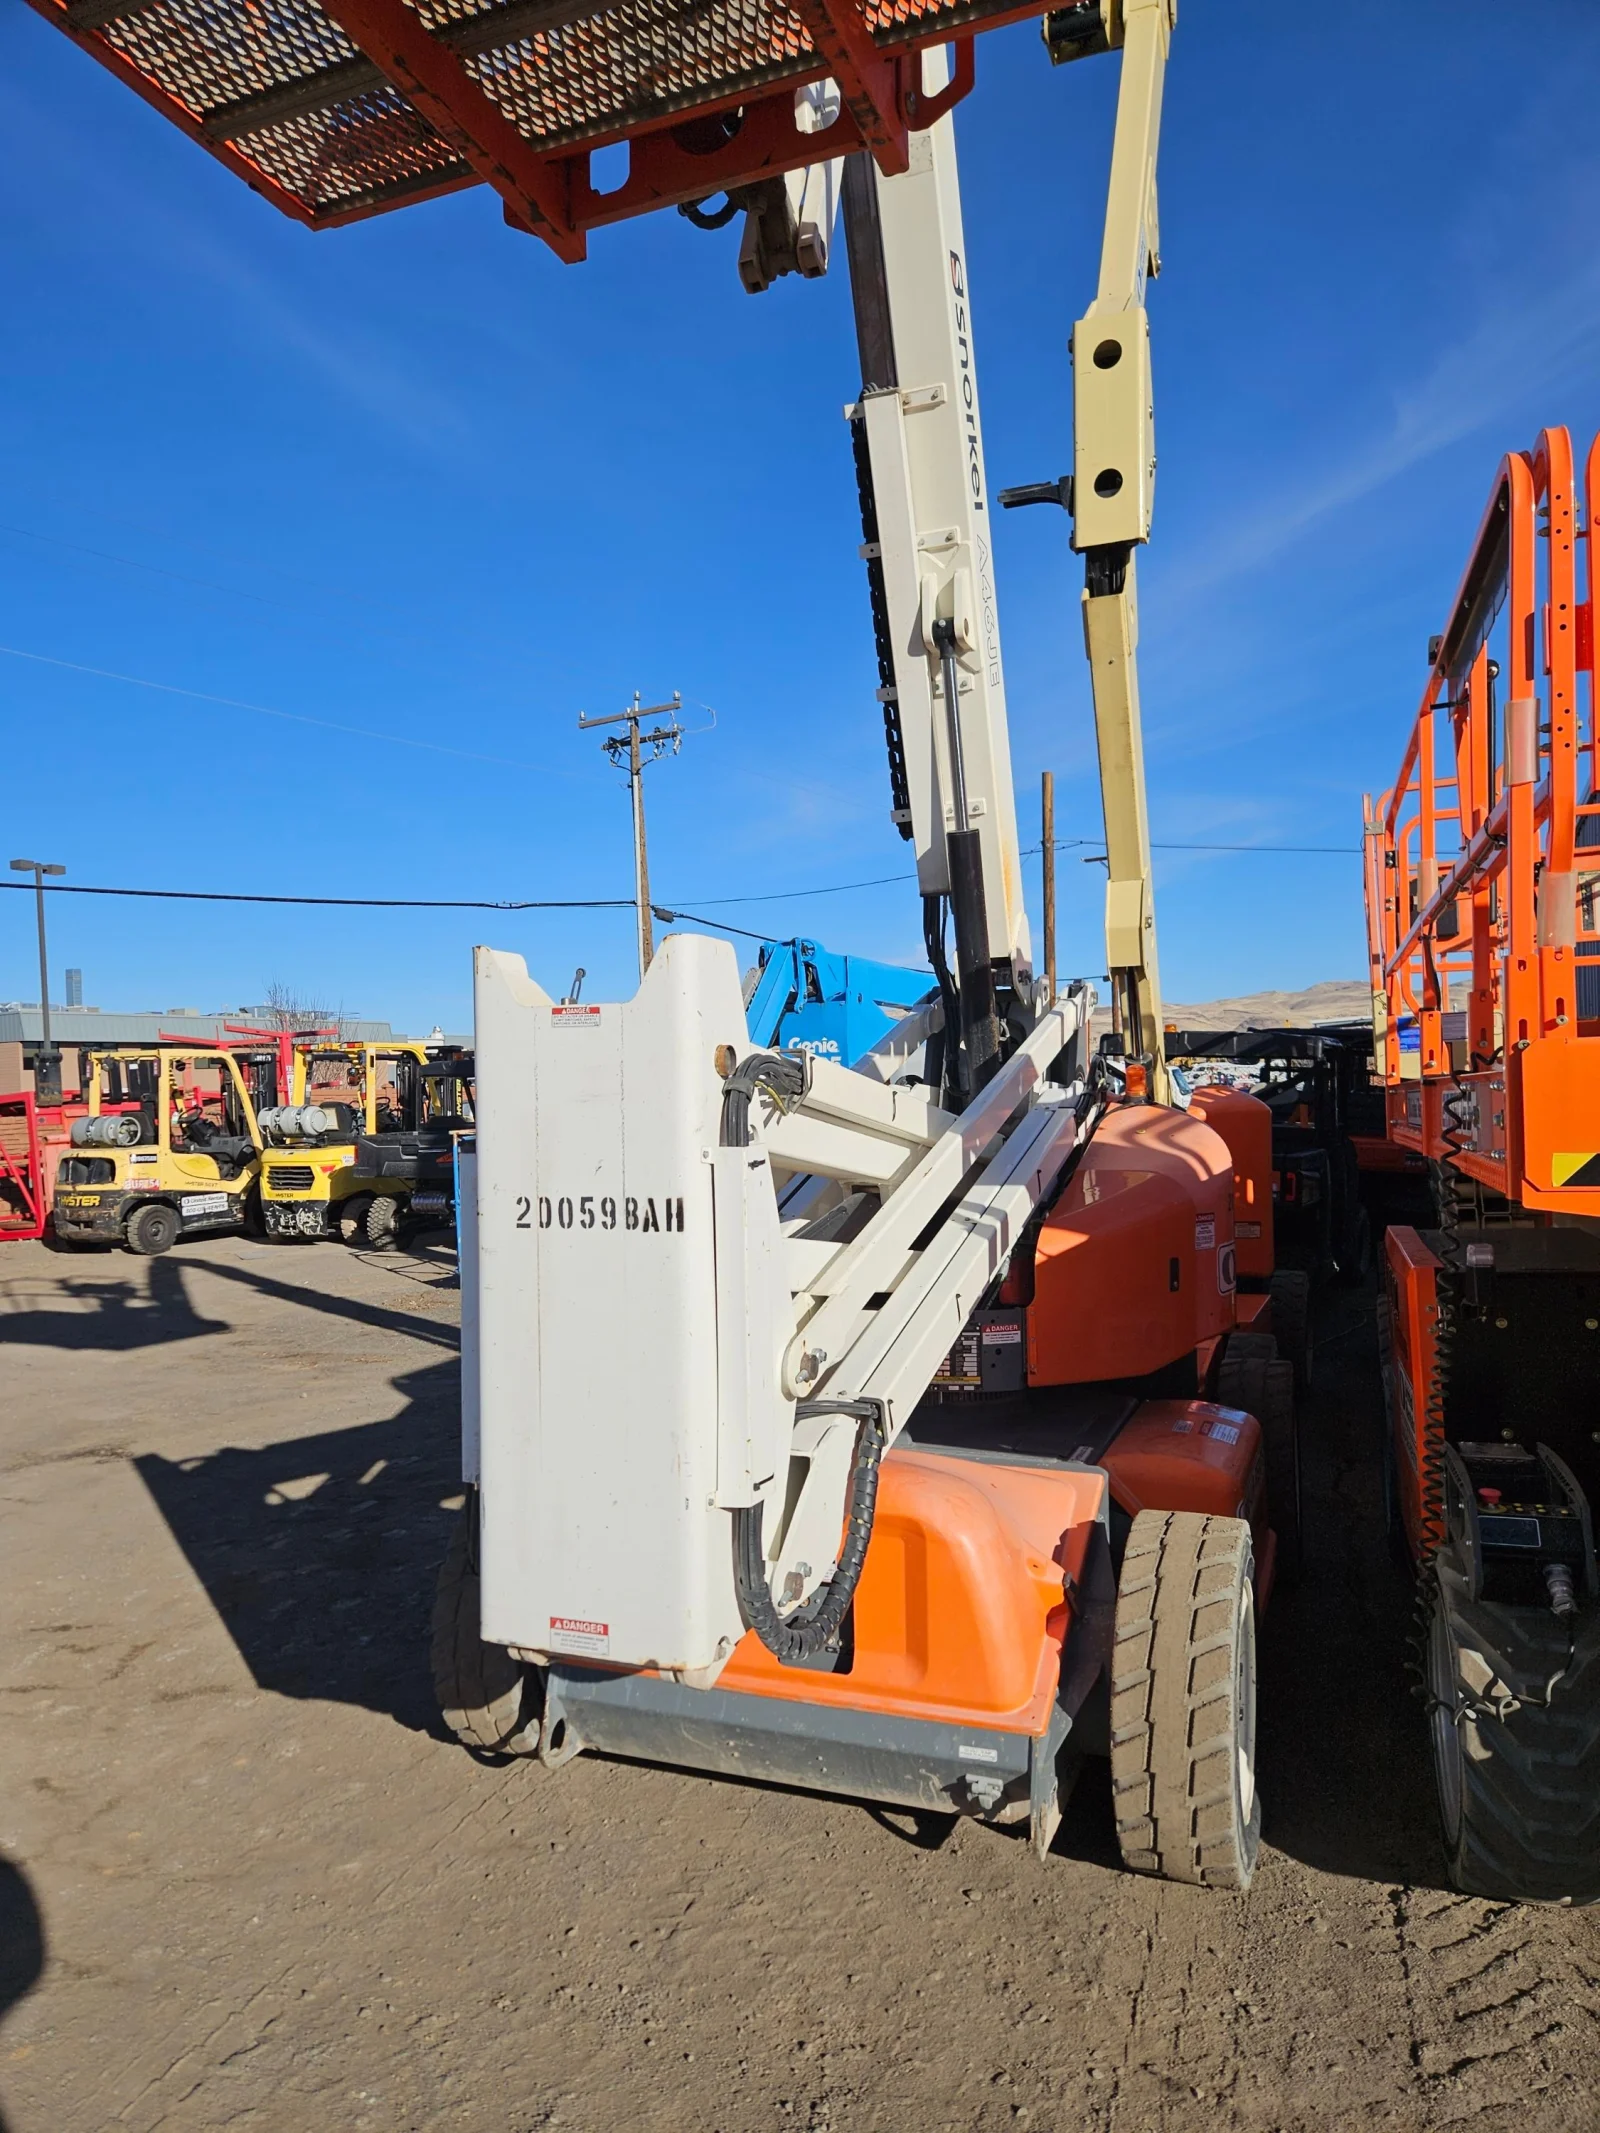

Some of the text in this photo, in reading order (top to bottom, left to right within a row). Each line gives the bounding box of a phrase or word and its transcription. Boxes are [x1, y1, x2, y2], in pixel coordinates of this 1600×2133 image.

[954, 302, 984, 511] snorkel
[788, 1036, 840, 1054] Genie
[60, 1195, 101, 1207] HYSTER
[516, 1196, 684, 1232] 20059BAH
[562, 1619, 604, 1634] DANGER
